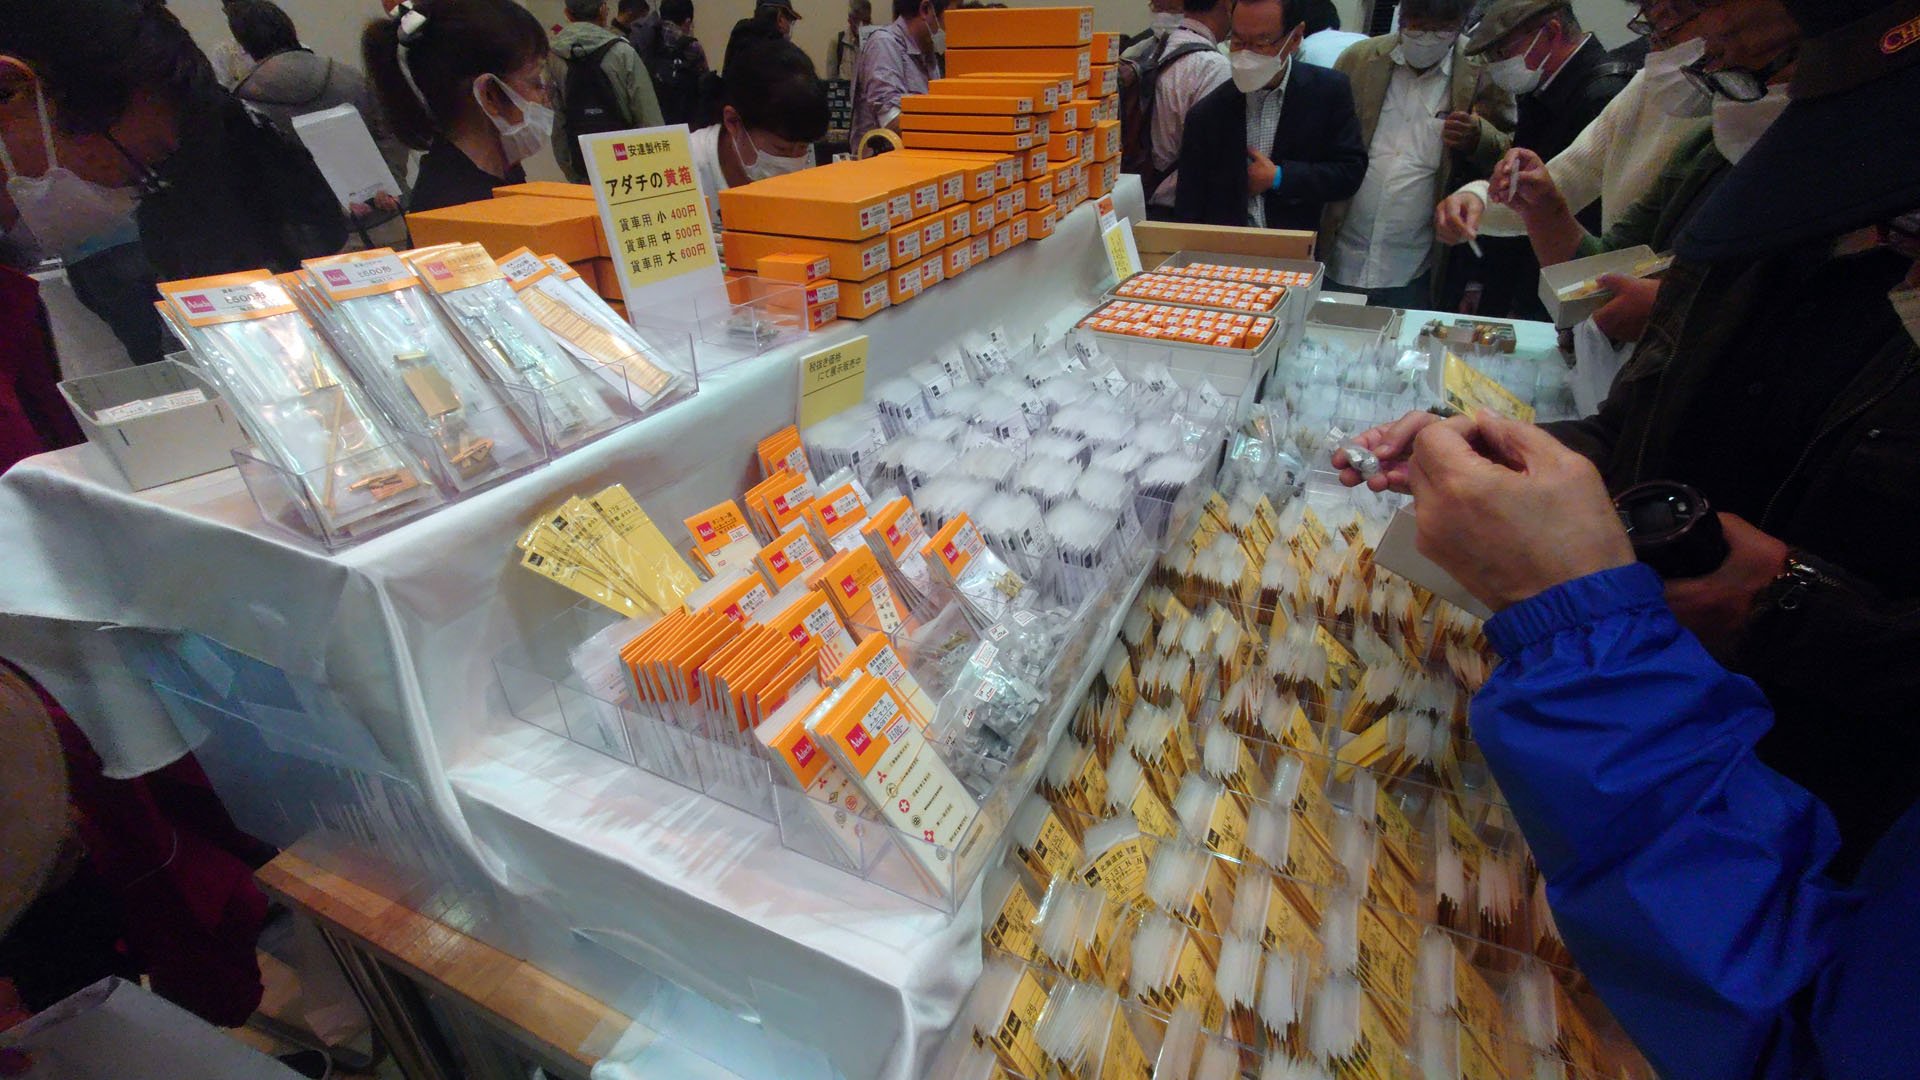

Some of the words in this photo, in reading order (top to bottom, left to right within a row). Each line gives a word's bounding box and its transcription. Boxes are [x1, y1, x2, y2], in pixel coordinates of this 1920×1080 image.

[627, 140, 671, 158] 安達製作所
[606, 166, 692, 196] アダチの黄箱
[619, 214, 652, 232] 貨車用
[657, 210, 666, 223] 小
[671, 204, 696, 220] 400円
[625, 234, 658, 253] 貨車用
[662, 230, 672, 244] 中
[676, 224, 702, 240] 500円
[630, 254, 662, 274] 貨車用
[666, 250, 678, 264] 大
[680, 242, 706, 260] 600円
